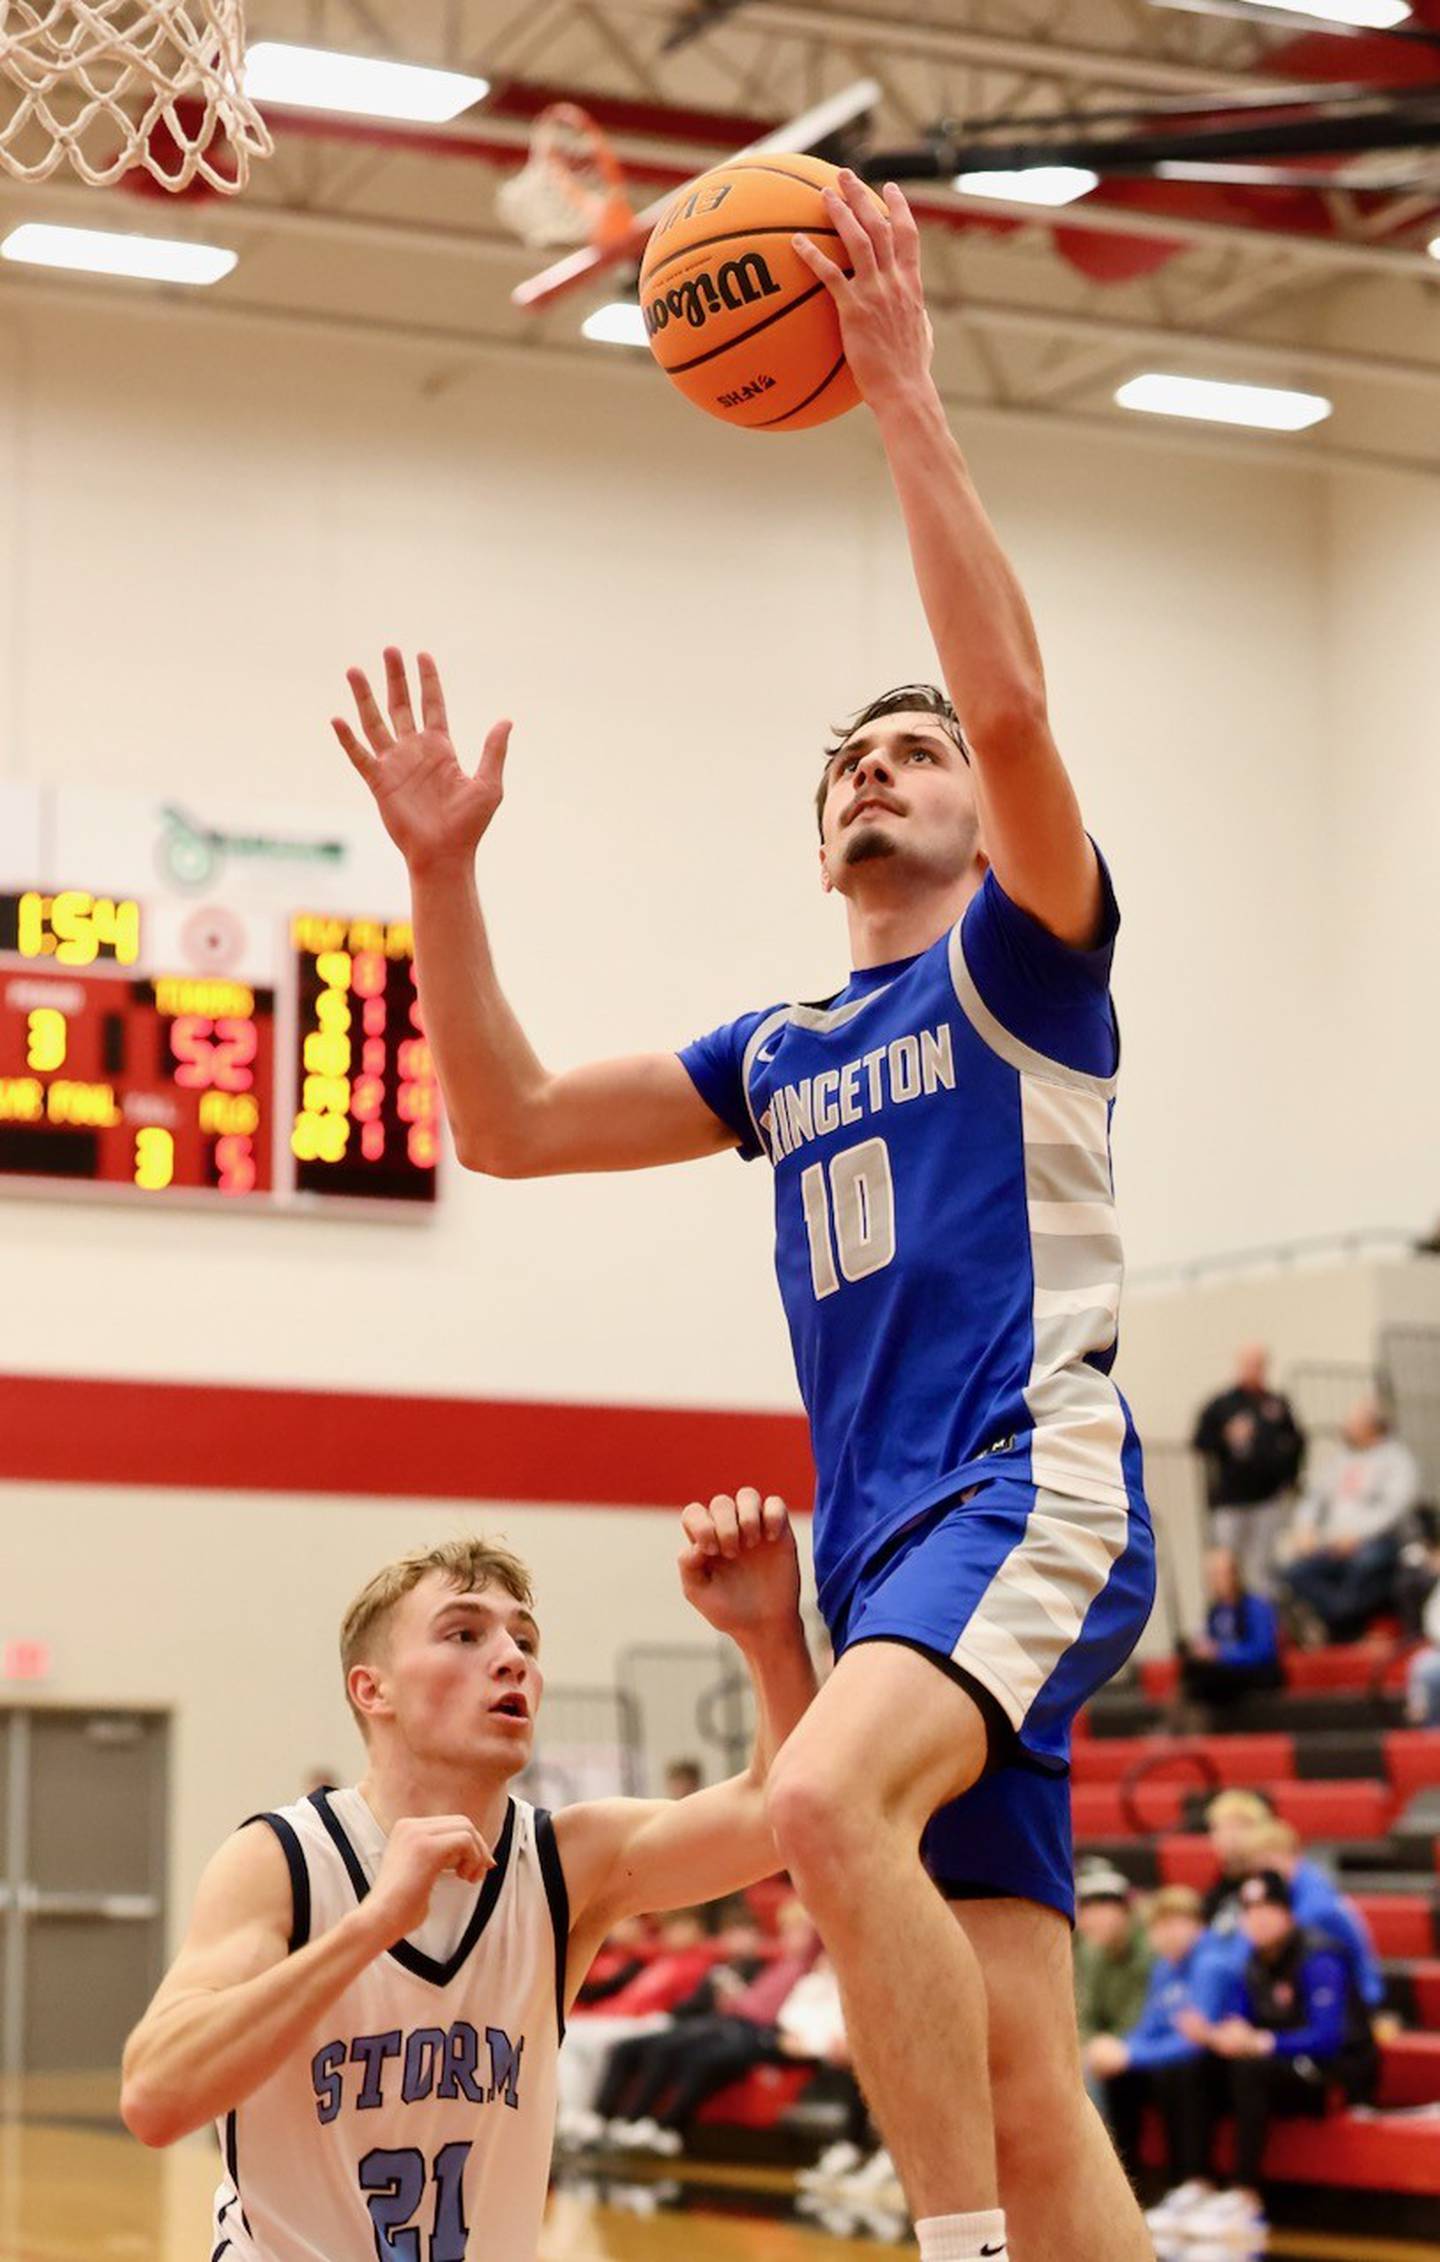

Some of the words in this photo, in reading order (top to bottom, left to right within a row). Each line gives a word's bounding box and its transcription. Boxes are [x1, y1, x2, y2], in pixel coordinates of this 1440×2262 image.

[718, 378, 767, 407] NFHS
[18, 891, 139, 966] 1:54
[27, 1008, 66, 1072] 3
[760, 1023, 956, 1166] INCETON
[135, 1127, 174, 1190] 3
[801, 1137, 896, 1301] 10
[311, 2021, 524, 2125] STORM
[358, 2140, 474, 2262] 21
